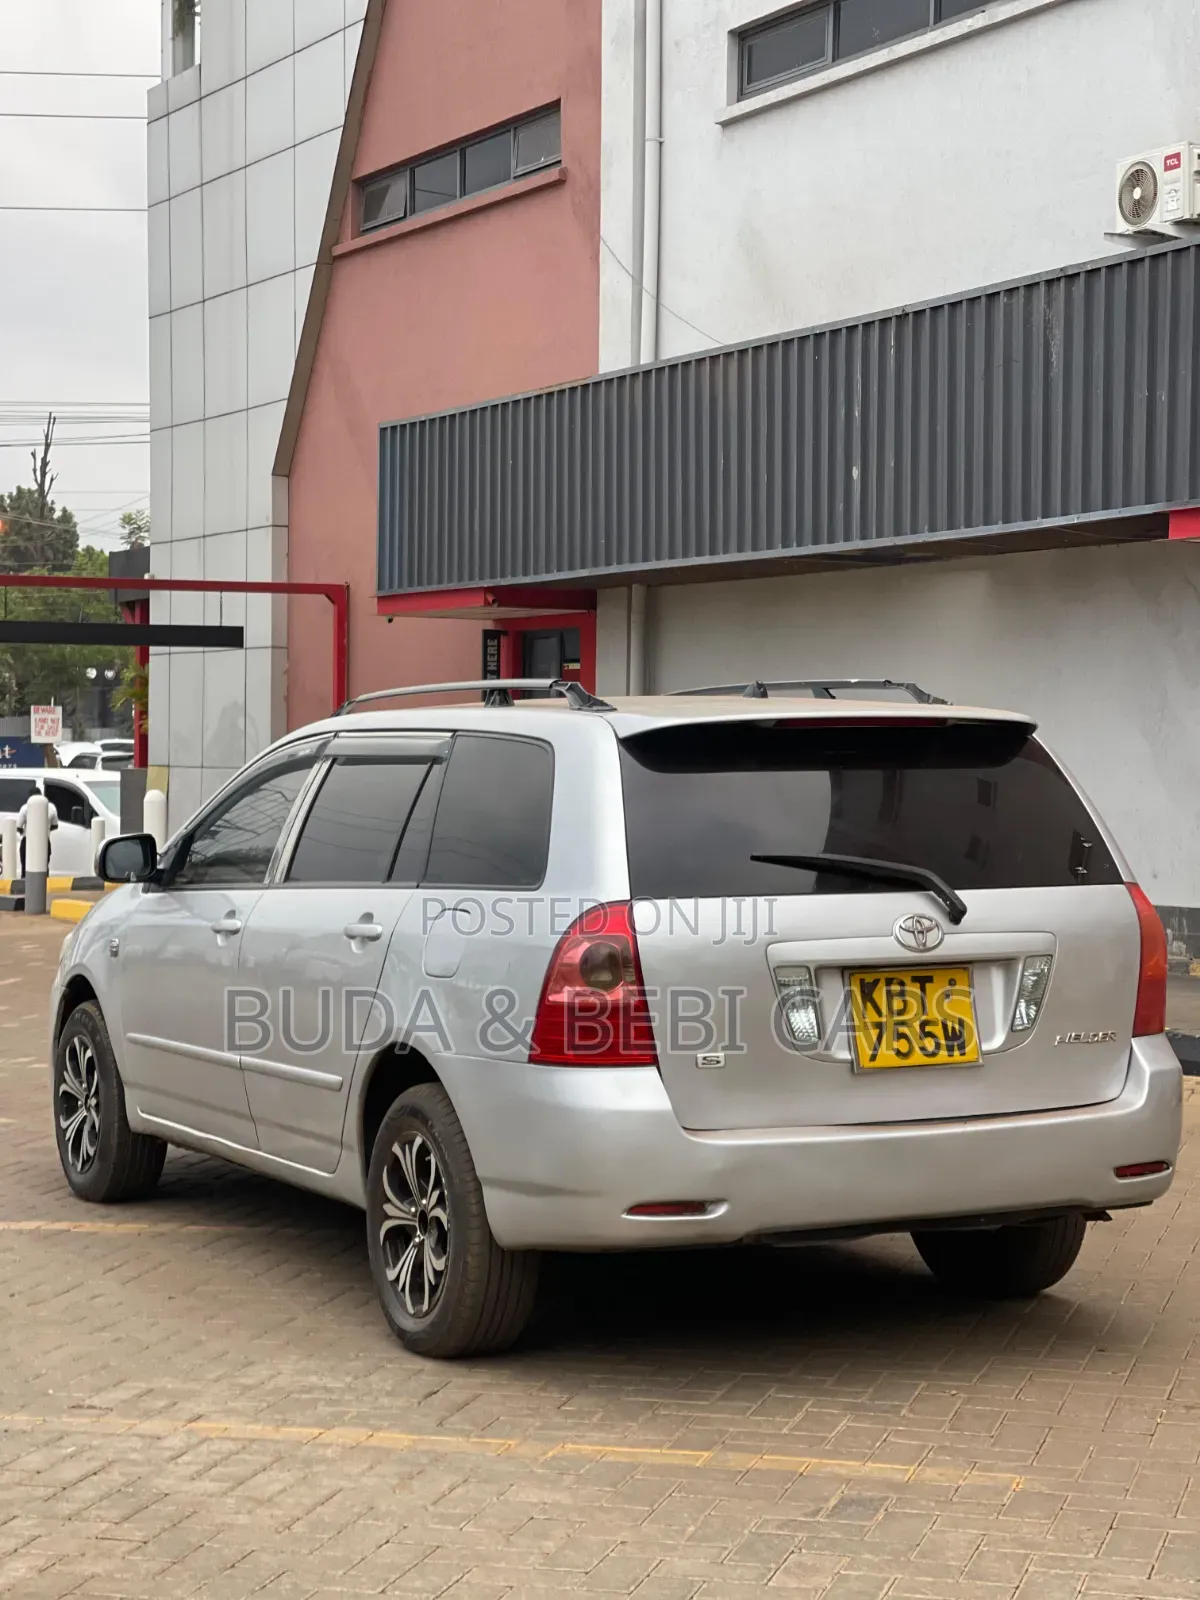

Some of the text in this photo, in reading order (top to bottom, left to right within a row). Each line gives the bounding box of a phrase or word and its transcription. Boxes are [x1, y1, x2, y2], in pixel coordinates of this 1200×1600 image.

[1166, 158, 1179, 167] TCL
[486, 639, 498, 671] HERE
[859, 975, 934, 1018] KBT
[865, 1016, 967, 1062] 755W
[701, 1055, 722, 1066] S
